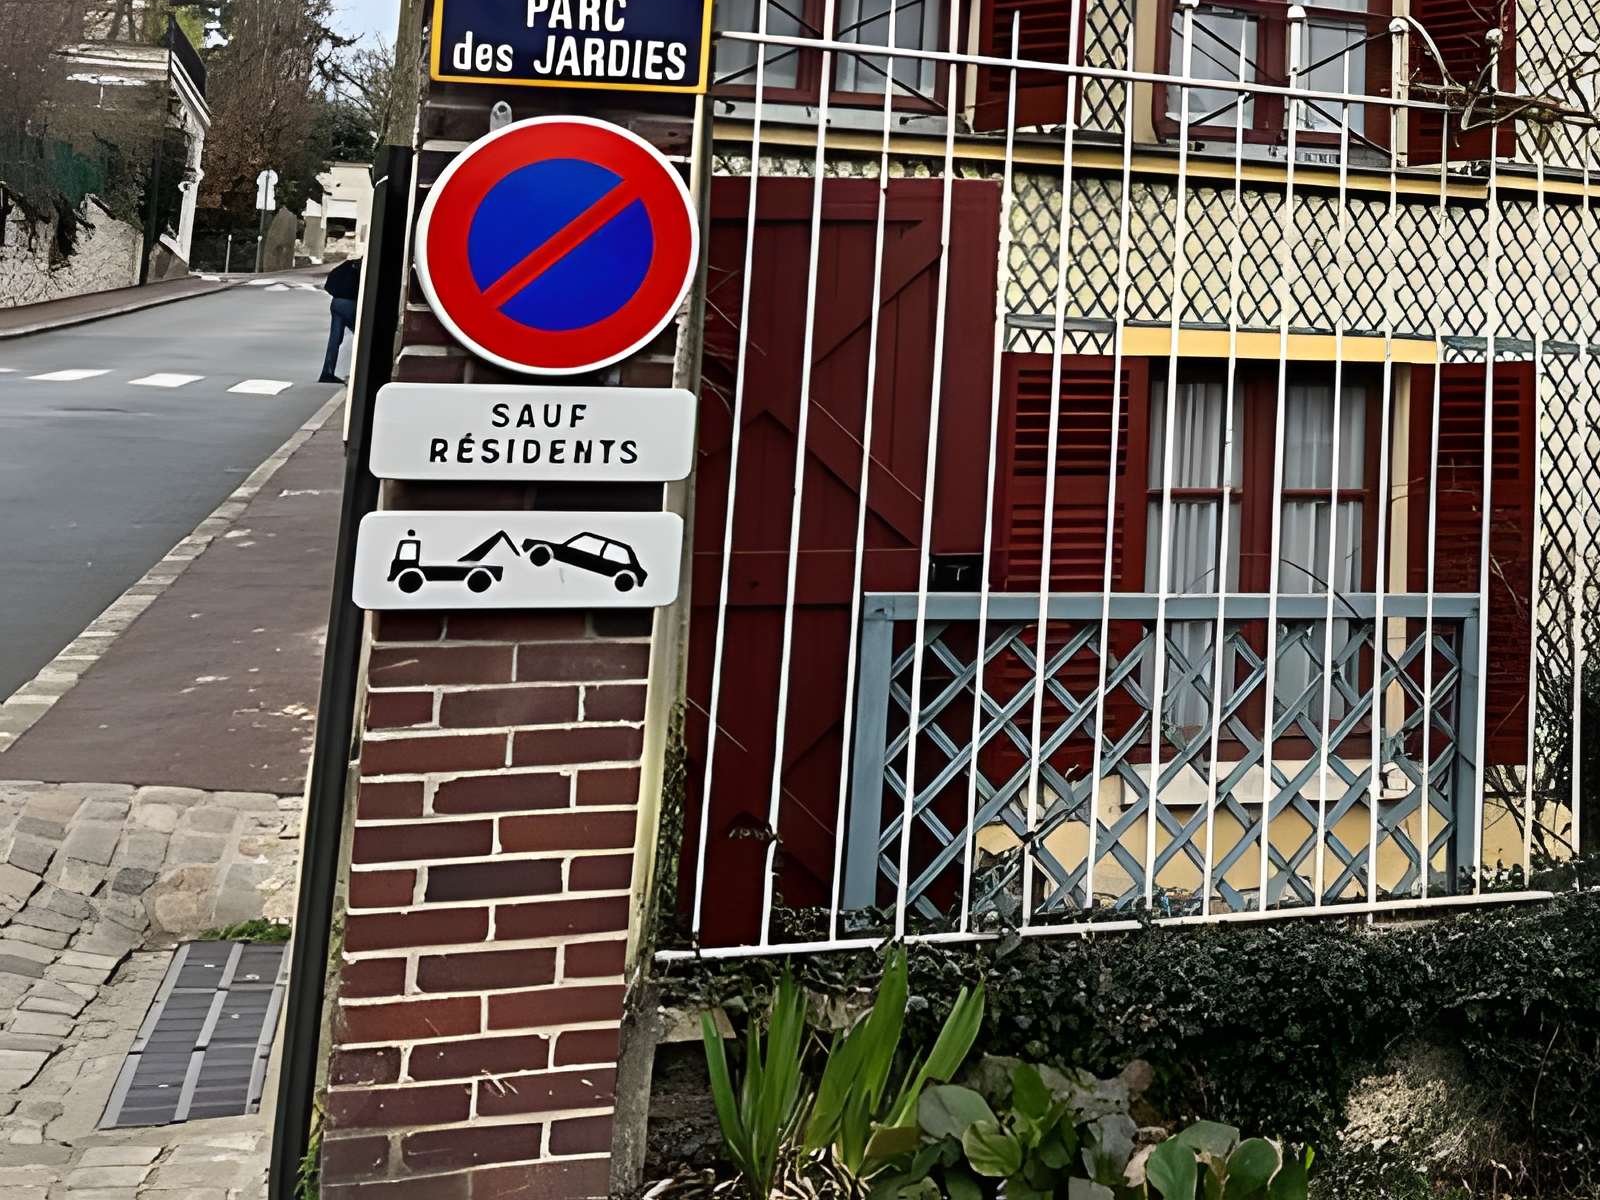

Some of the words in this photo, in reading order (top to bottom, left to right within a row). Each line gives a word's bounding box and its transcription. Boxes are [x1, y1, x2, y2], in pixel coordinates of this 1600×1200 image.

[452, 31, 514, 72] des
[533, 35, 687, 81] JARDIES
[491, 403, 587, 428] SAUF
[429, 432, 638, 464] RÉSIDENTS
